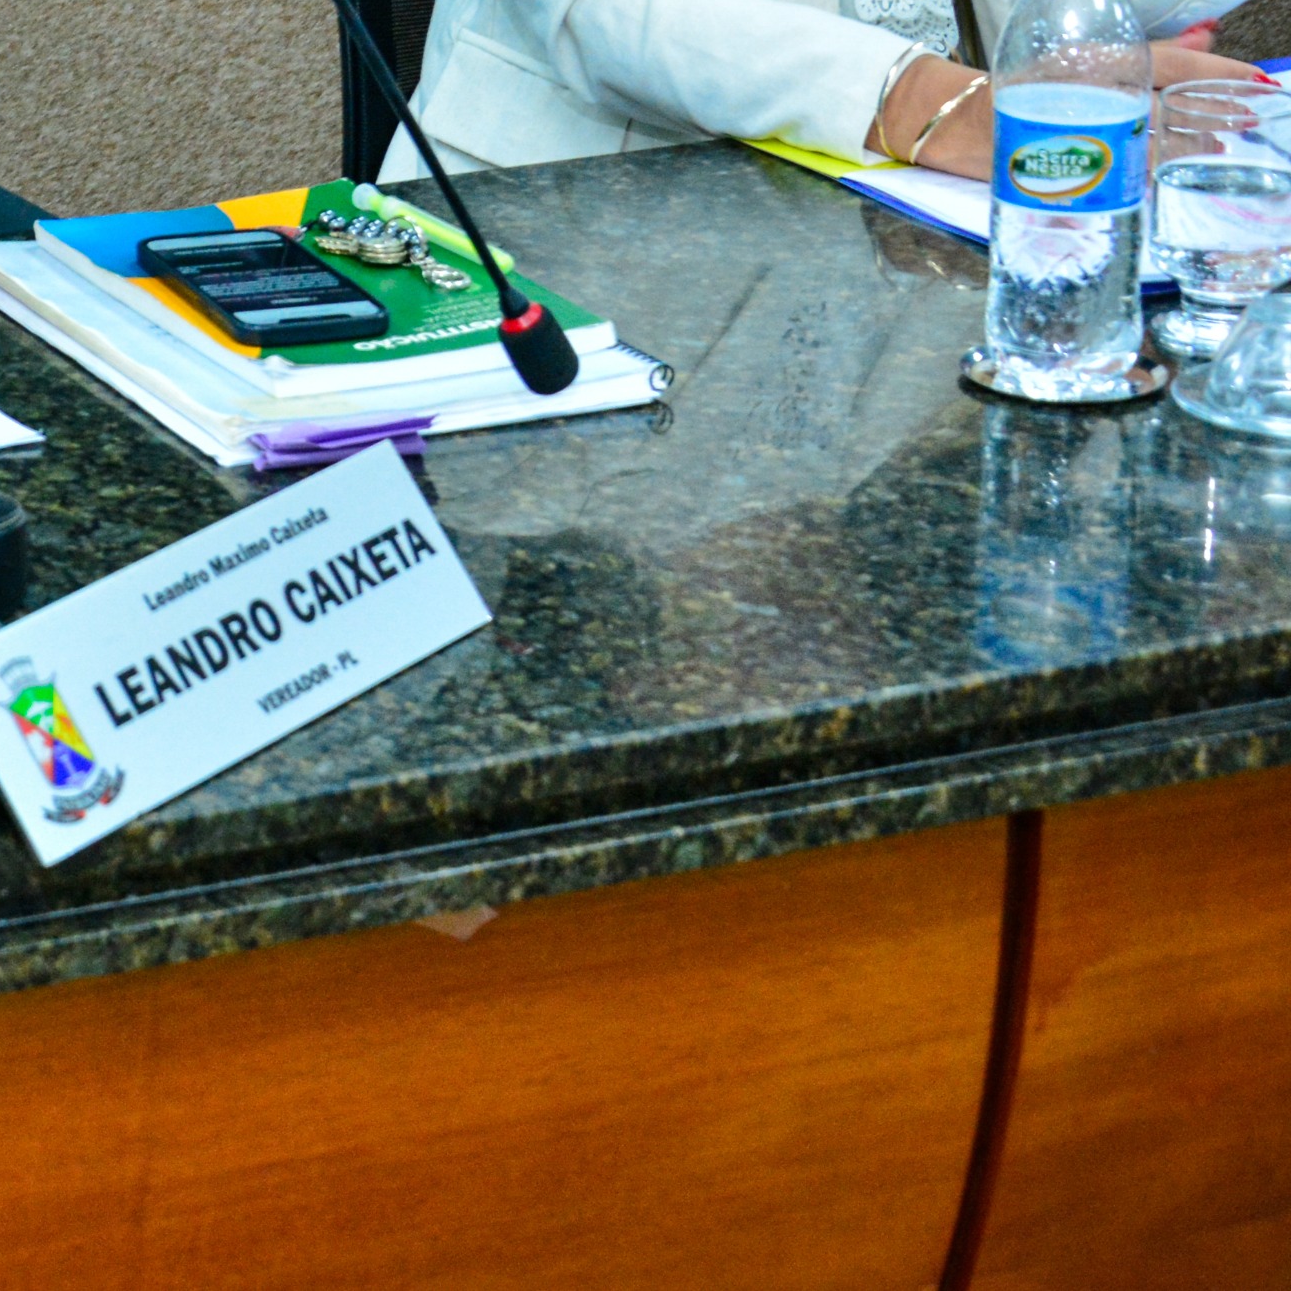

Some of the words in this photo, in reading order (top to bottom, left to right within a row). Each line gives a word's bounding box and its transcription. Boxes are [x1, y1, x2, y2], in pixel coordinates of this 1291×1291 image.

[1024, 159, 1082, 177] Negra
[1037, 148, 1091, 167] Serra
[143, 570, 210, 611] Leandro
[209, 538, 271, 577] Maximo
[270, 508, 329, 545] Caixeta
[93, 599, 282, 727] LEANDRO
[283, 519, 437, 624] CAIXETA
[257, 663, 332, 714] VEREADOR
[338, 650, 359, 670] PL
